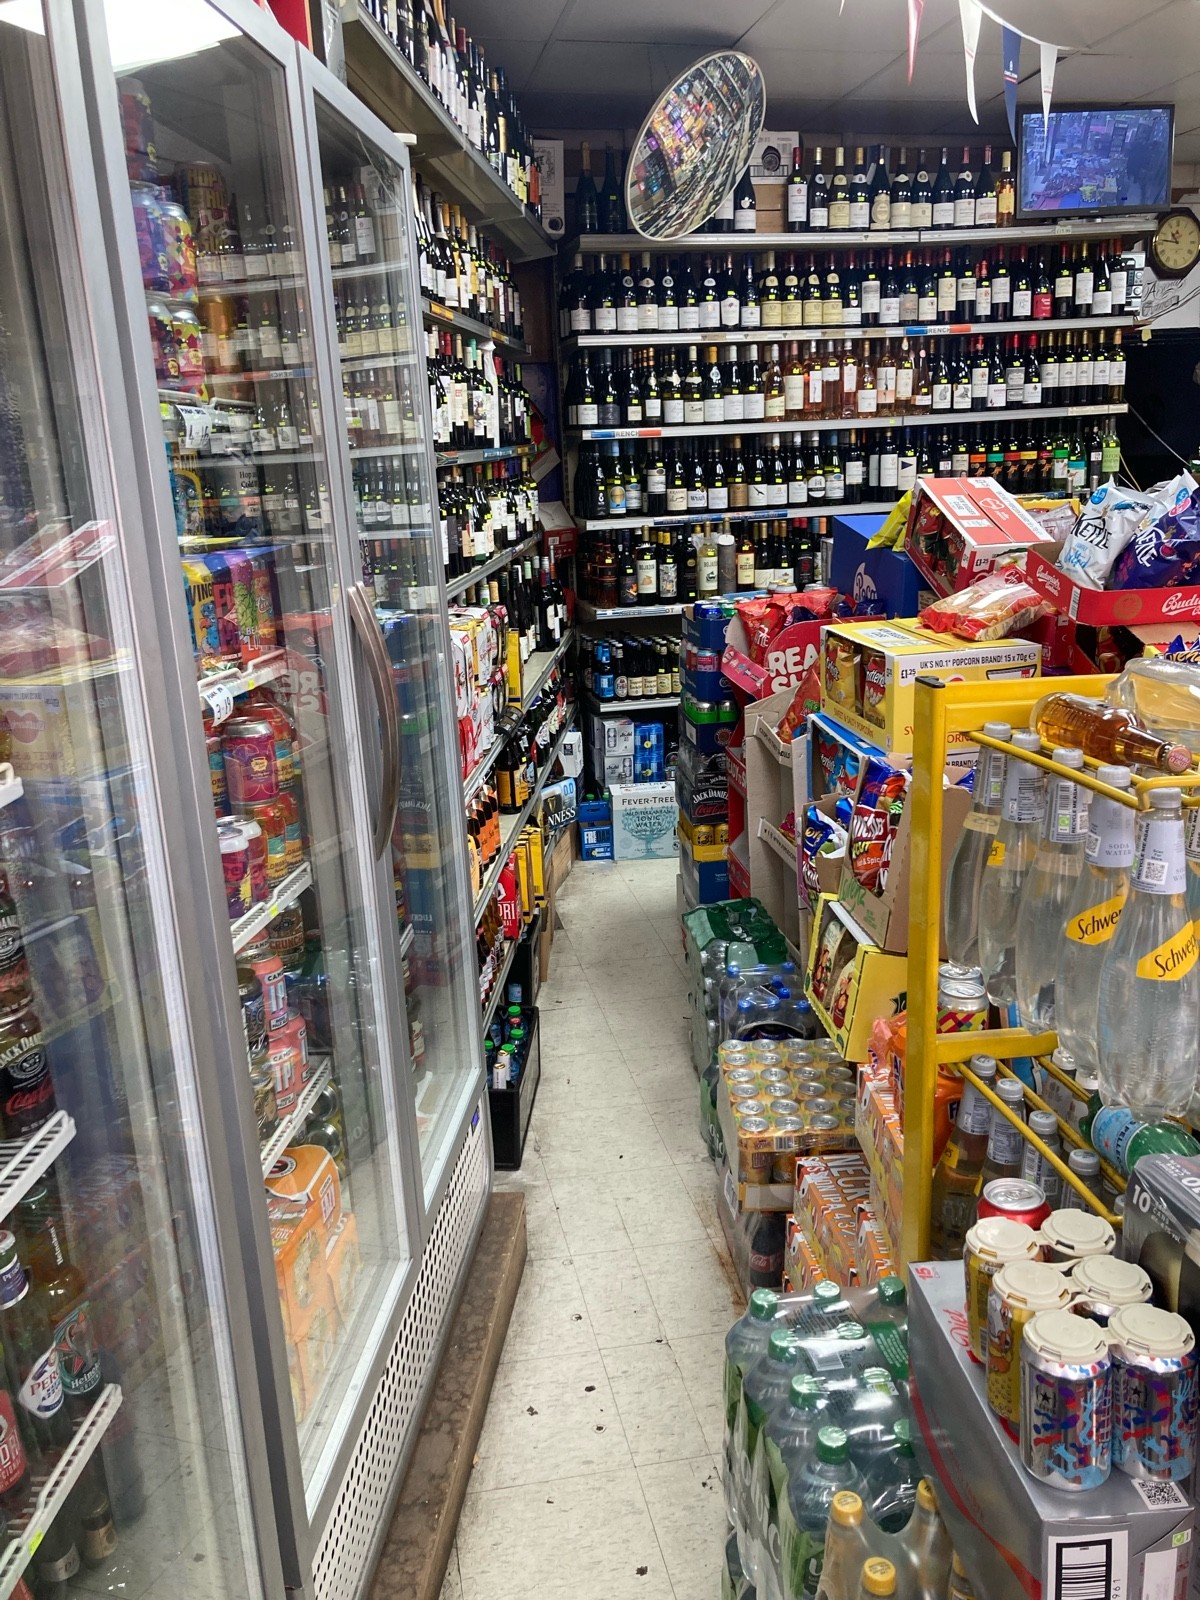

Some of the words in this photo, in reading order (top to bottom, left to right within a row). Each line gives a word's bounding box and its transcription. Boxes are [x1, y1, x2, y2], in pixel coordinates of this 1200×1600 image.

[1071, 513, 1113, 550] KETTLE
[920, 660, 934, 669] UK'S
[952, 657, 980, 666] POPCORN
[981, 655, 1003, 664] BRAND!
[1004, 654, 1012, 662] 15
[1016, 653, 1028, 662] 70g
[900, 668, 916, 679] £1.25
[563, 783, 574, 796] 0.0
[692, 790, 709, 804] JACK
[622, 796, 675, 806] FEVER-TREE
[1078, 909, 1122, 940] Schwe
[821, 1154, 870, 1201] NECK
[1132, 1185, 1151, 1213] 10
[914, 1265, 934, 1280] 15
[942, 1308, 970, 1347] Diet
